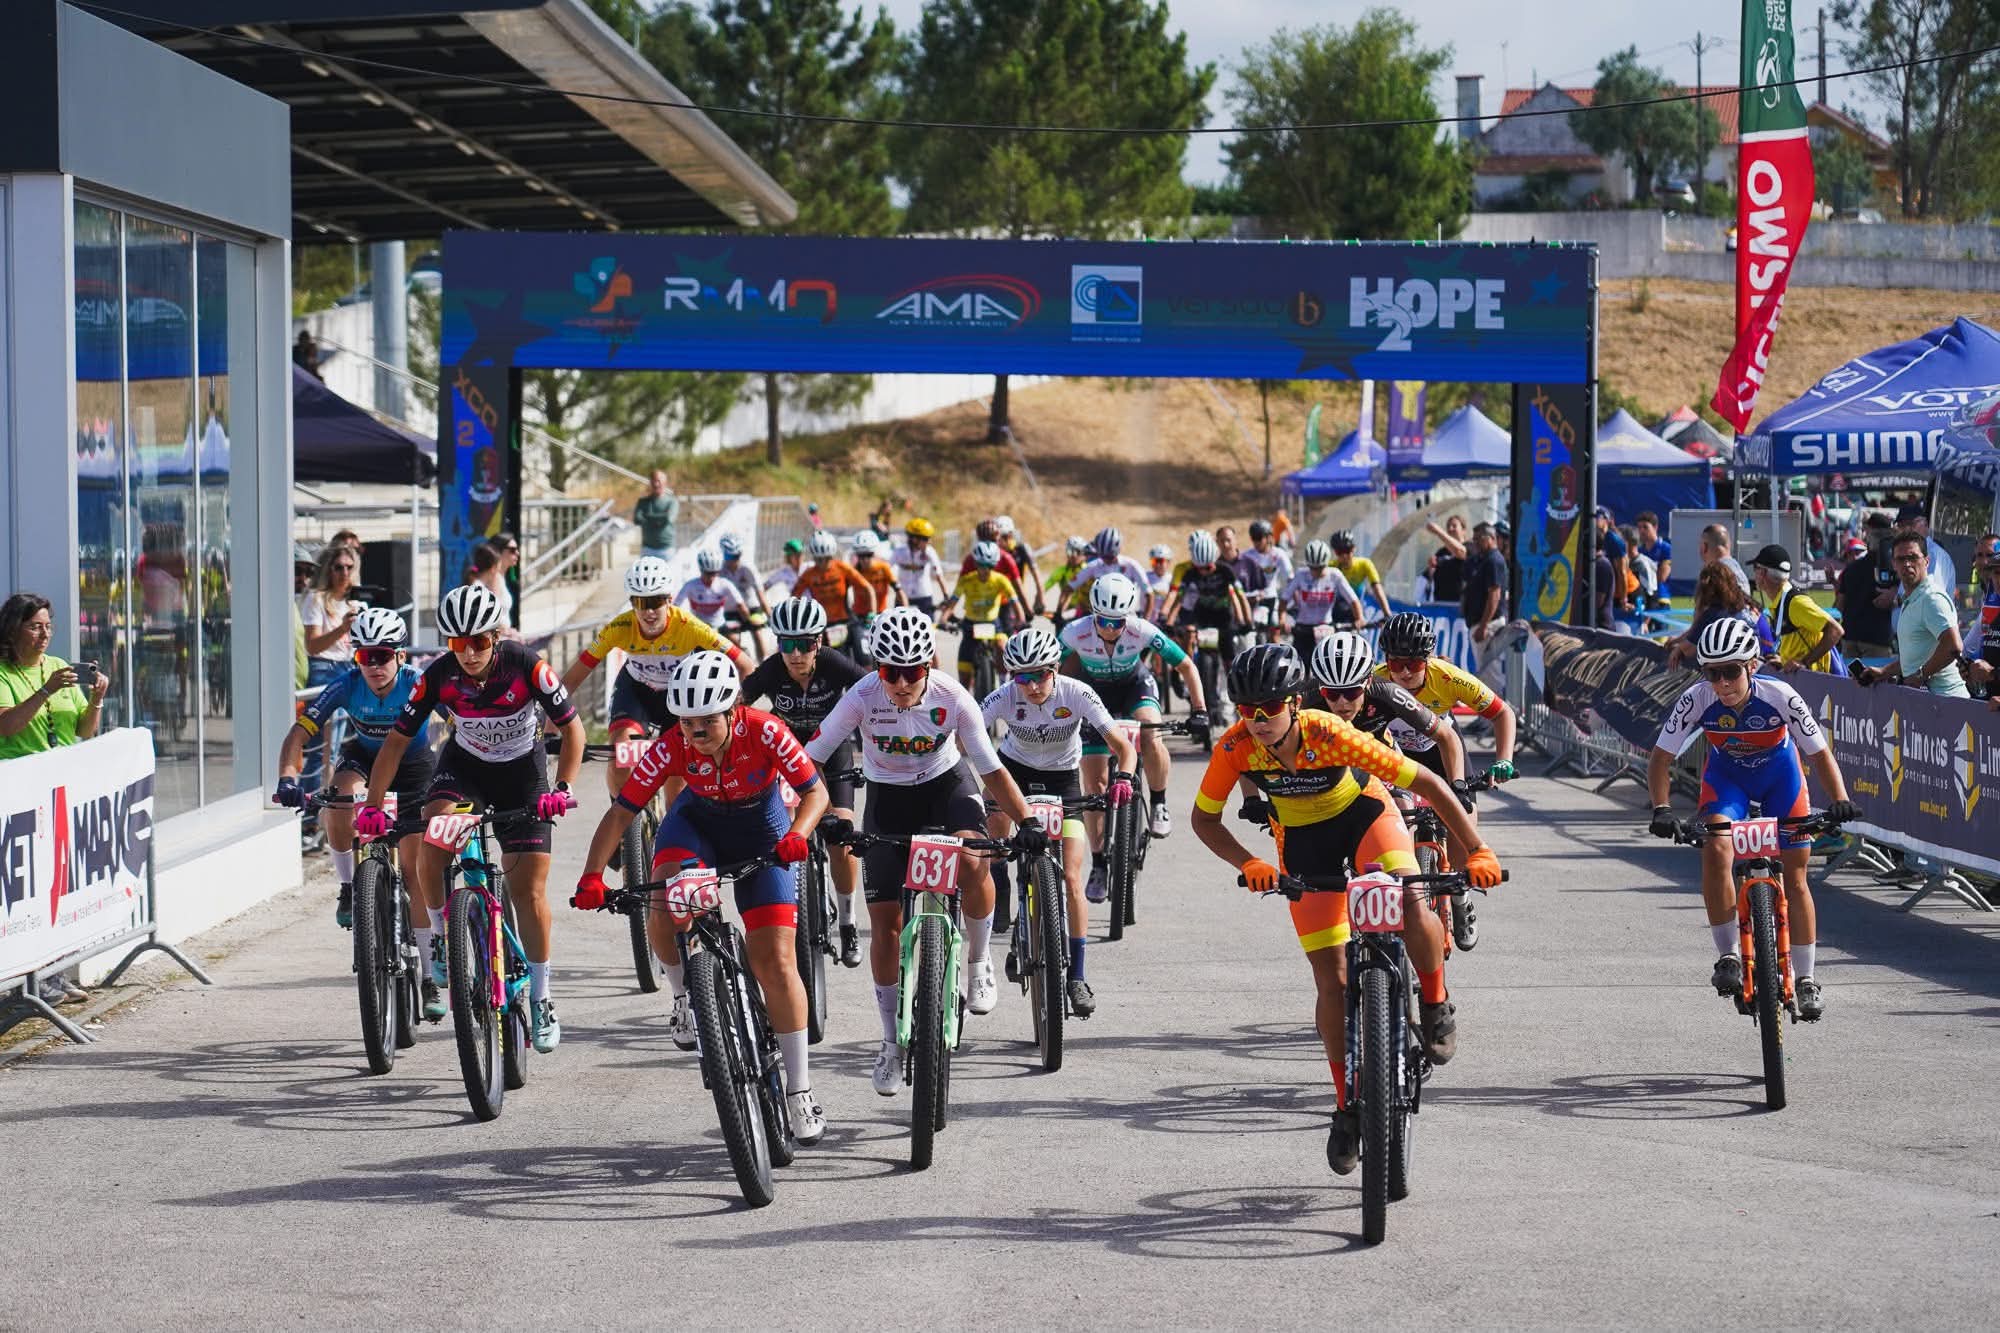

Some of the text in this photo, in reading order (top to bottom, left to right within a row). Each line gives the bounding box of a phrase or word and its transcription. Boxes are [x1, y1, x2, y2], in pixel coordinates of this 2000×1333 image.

[875, 292, 1019, 319] AMA
[1349, 277, 1505, 329] HOPE
[452, 368, 498, 436] XCO
[1531, 385, 1576, 450] XCO
[457, 420, 475, 447] 2
[1535, 438, 1552, 464] 2
[462, 711, 527, 730] CAIADO
[1733, 823, 1778, 854] 604
[911, 847, 958, 889] 631
[1350, 885, 1401, 927] 608
